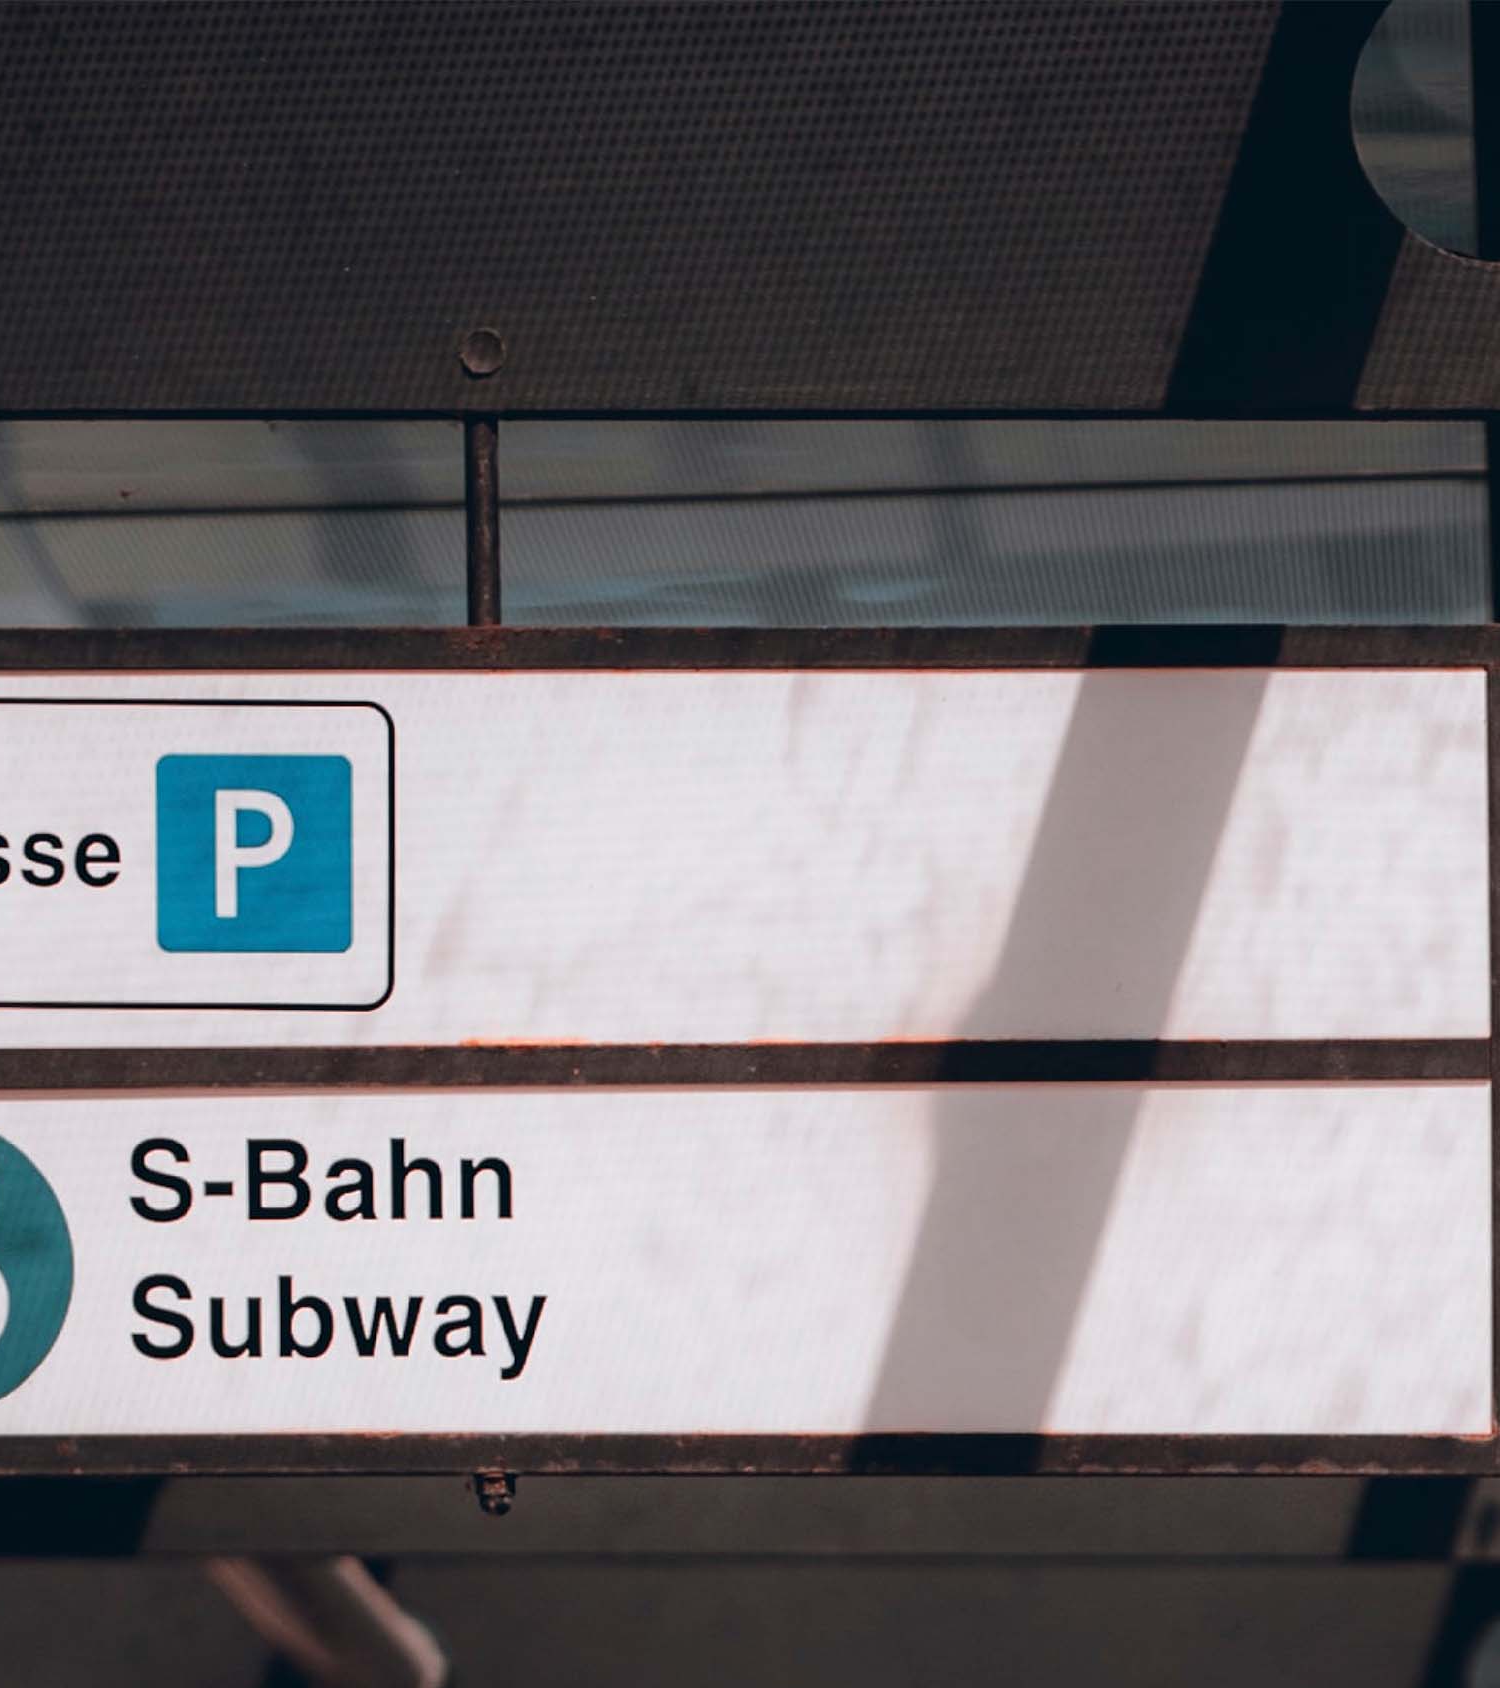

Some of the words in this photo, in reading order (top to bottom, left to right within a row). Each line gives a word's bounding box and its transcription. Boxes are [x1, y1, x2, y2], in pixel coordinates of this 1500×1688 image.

[215, 789, 294, 918] P
[129, 1137, 513, 1223] S-Bahn
[131, 1273, 547, 1381] Subway
